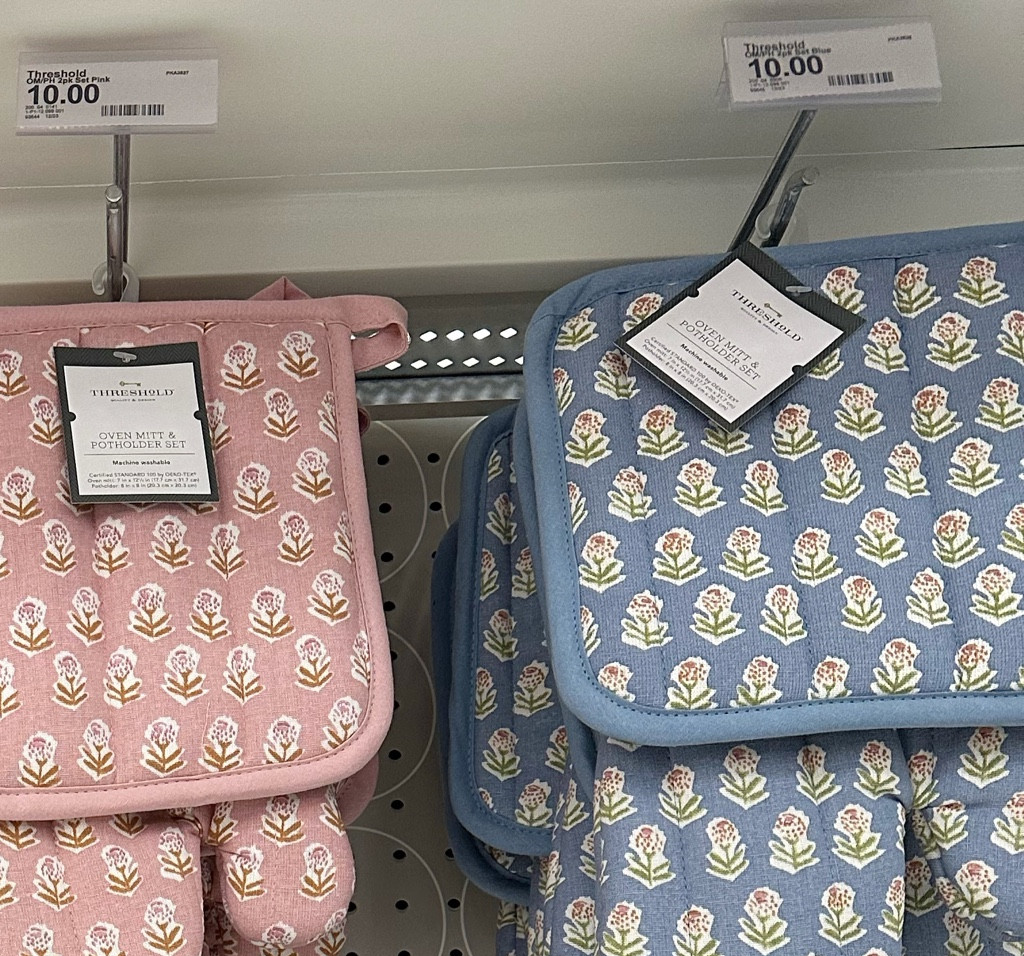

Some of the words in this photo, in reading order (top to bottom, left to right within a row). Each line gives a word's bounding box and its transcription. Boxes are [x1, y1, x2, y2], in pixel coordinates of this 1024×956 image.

[744, 40, 805, 53] Threshold
[28, 69, 86, 79] Threshold
[748, 55, 823, 79] 10.00
[58, 77, 73, 85] 2pk
[28, 84, 99, 105] 10.00
[732, 289, 801, 341] THRESHOLD
[679, 320, 740, 366] POTHOLDER
[739, 365, 761, 380] SET
[695, 320, 726, 343] OVEN
[724, 341, 752, 361] MITT
[680, 344, 703, 361] Machine
[703, 361, 728, 380] washable
[91, 441, 162, 449] POTHOLDER
[165, 440, 186, 448] SET
[99, 432, 132, 440] OVEN
